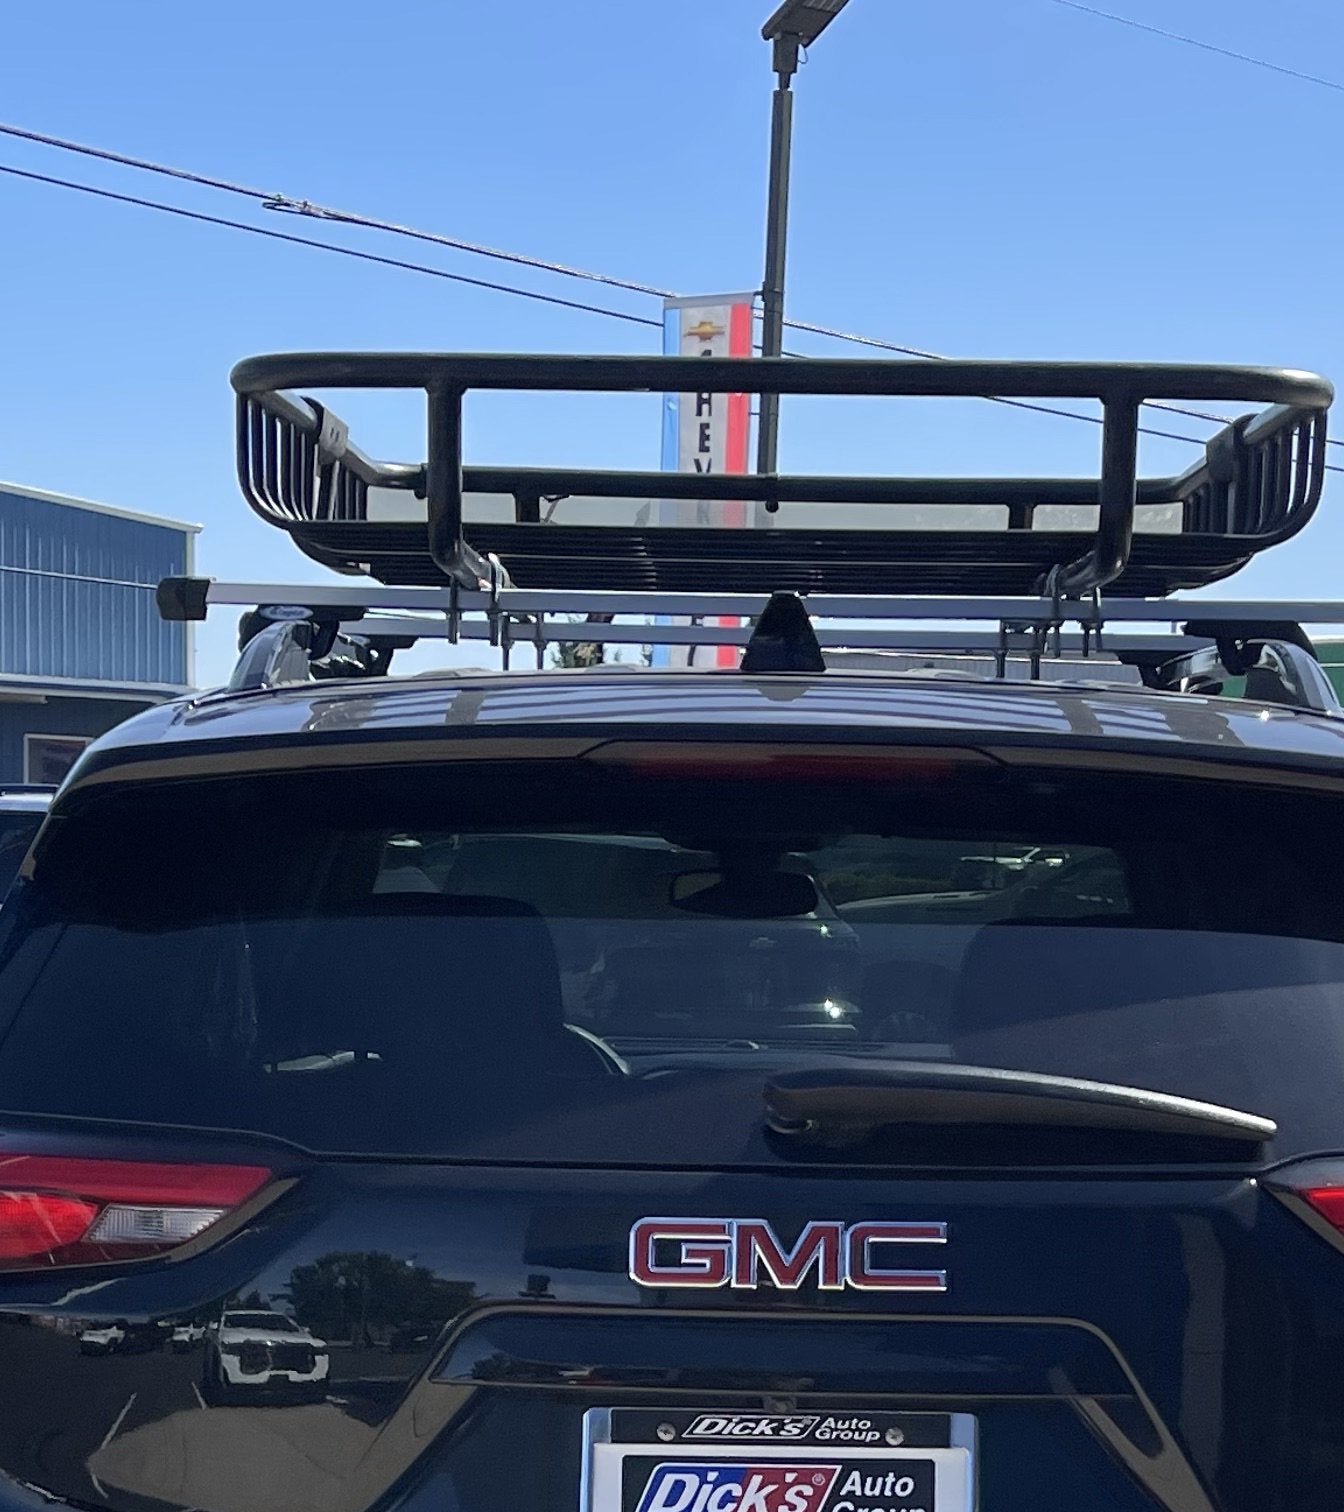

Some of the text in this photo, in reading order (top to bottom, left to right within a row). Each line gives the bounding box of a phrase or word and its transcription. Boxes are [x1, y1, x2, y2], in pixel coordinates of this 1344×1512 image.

[629, 1216, 948, 1292] GMC
[692, 1415, 807, 1436] Dick's
[819, 1416, 871, 1430] Auto
[815, 1427, 881, 1443] Group
[839, 1470, 915, 1498] Auto
